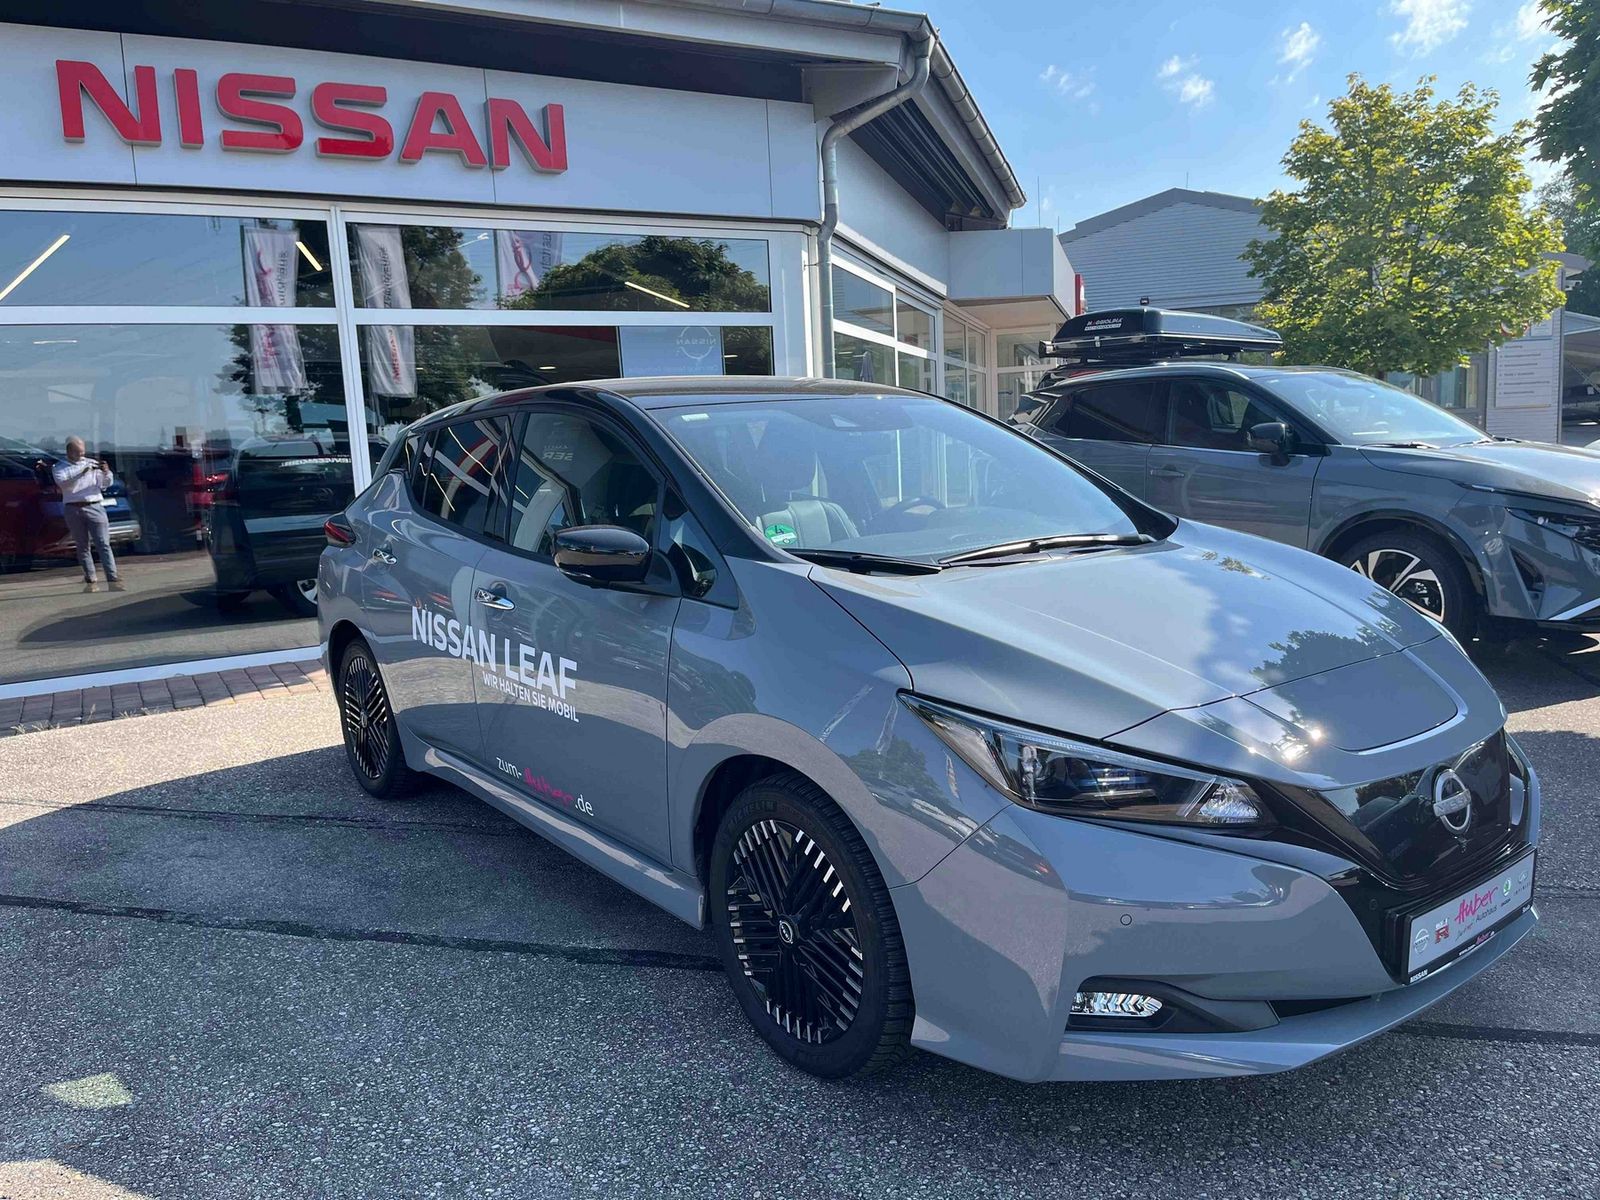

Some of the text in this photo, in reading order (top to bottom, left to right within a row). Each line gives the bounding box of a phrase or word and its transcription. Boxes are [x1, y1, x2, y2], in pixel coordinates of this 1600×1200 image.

[56, 59, 569, 174] NISSAN
[412, 605, 578, 700] NISSAN LEAF
[482, 671, 580, 723] WIR HALTEN SIE MOBIL
